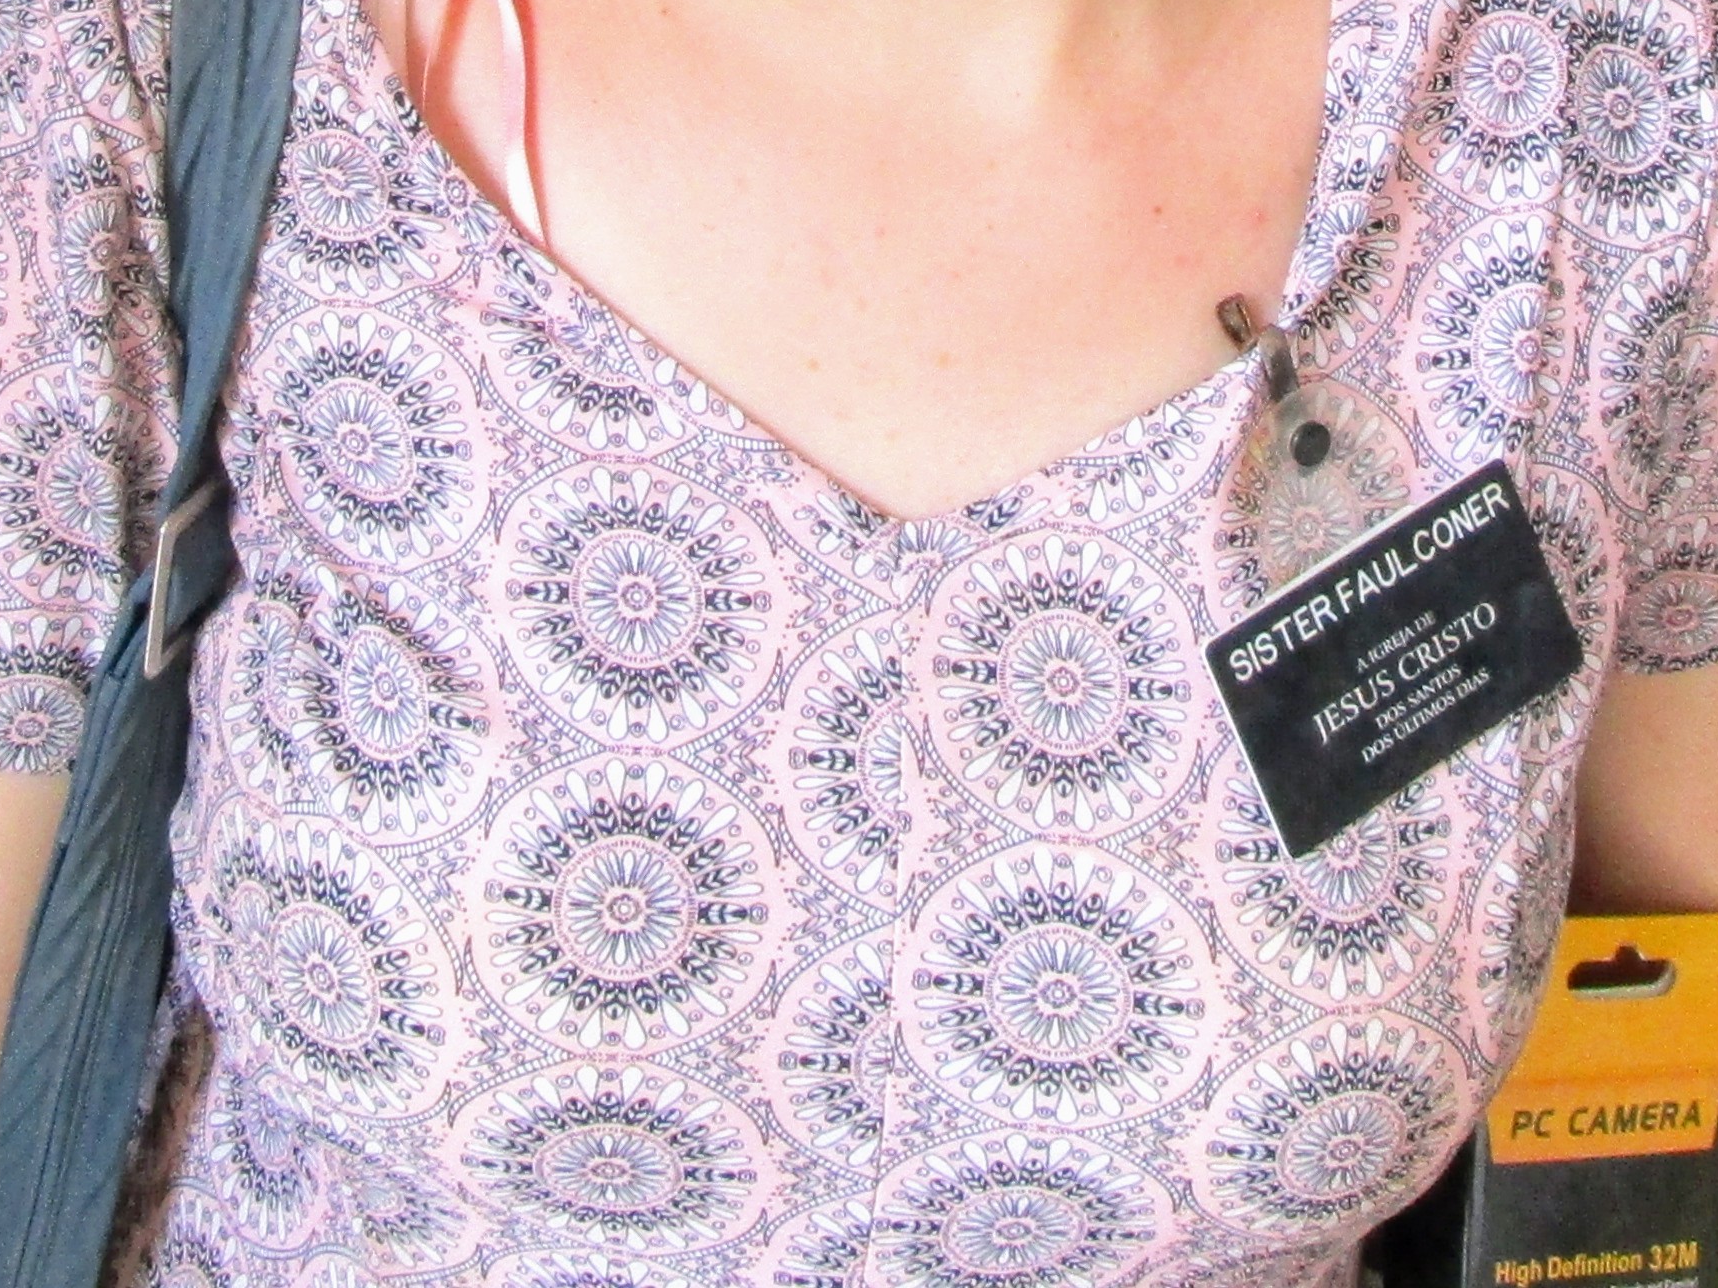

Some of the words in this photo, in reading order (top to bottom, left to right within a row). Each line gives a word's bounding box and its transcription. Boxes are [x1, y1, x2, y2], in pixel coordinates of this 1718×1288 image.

[1229, 593, 1339, 682] SISTER
[1334, 481, 1511, 615] FAULCONER
[1312, 668, 1396, 746] JESUS
[1397, 601, 1497, 681] CRISTO
[1355, 656, 1369, 674] A
[1367, 625, 1416, 664] IGREJA
[1414, 609, 1437, 633] DE
[1360, 732, 1395, 765] DOS
[1455, 667, 1492, 700] DIAS
[1374, 701, 1408, 731] DOS
[1407, 662, 1463, 708] SANTOS
[1510, 1109, 1555, 1140] PC
[1568, 1099, 1703, 1137] CAMERA
[1494, 1258, 1543, 1288] High
[1546, 1249, 1643, 1281] Definition
[1649, 1240, 1699, 1272] 32M
